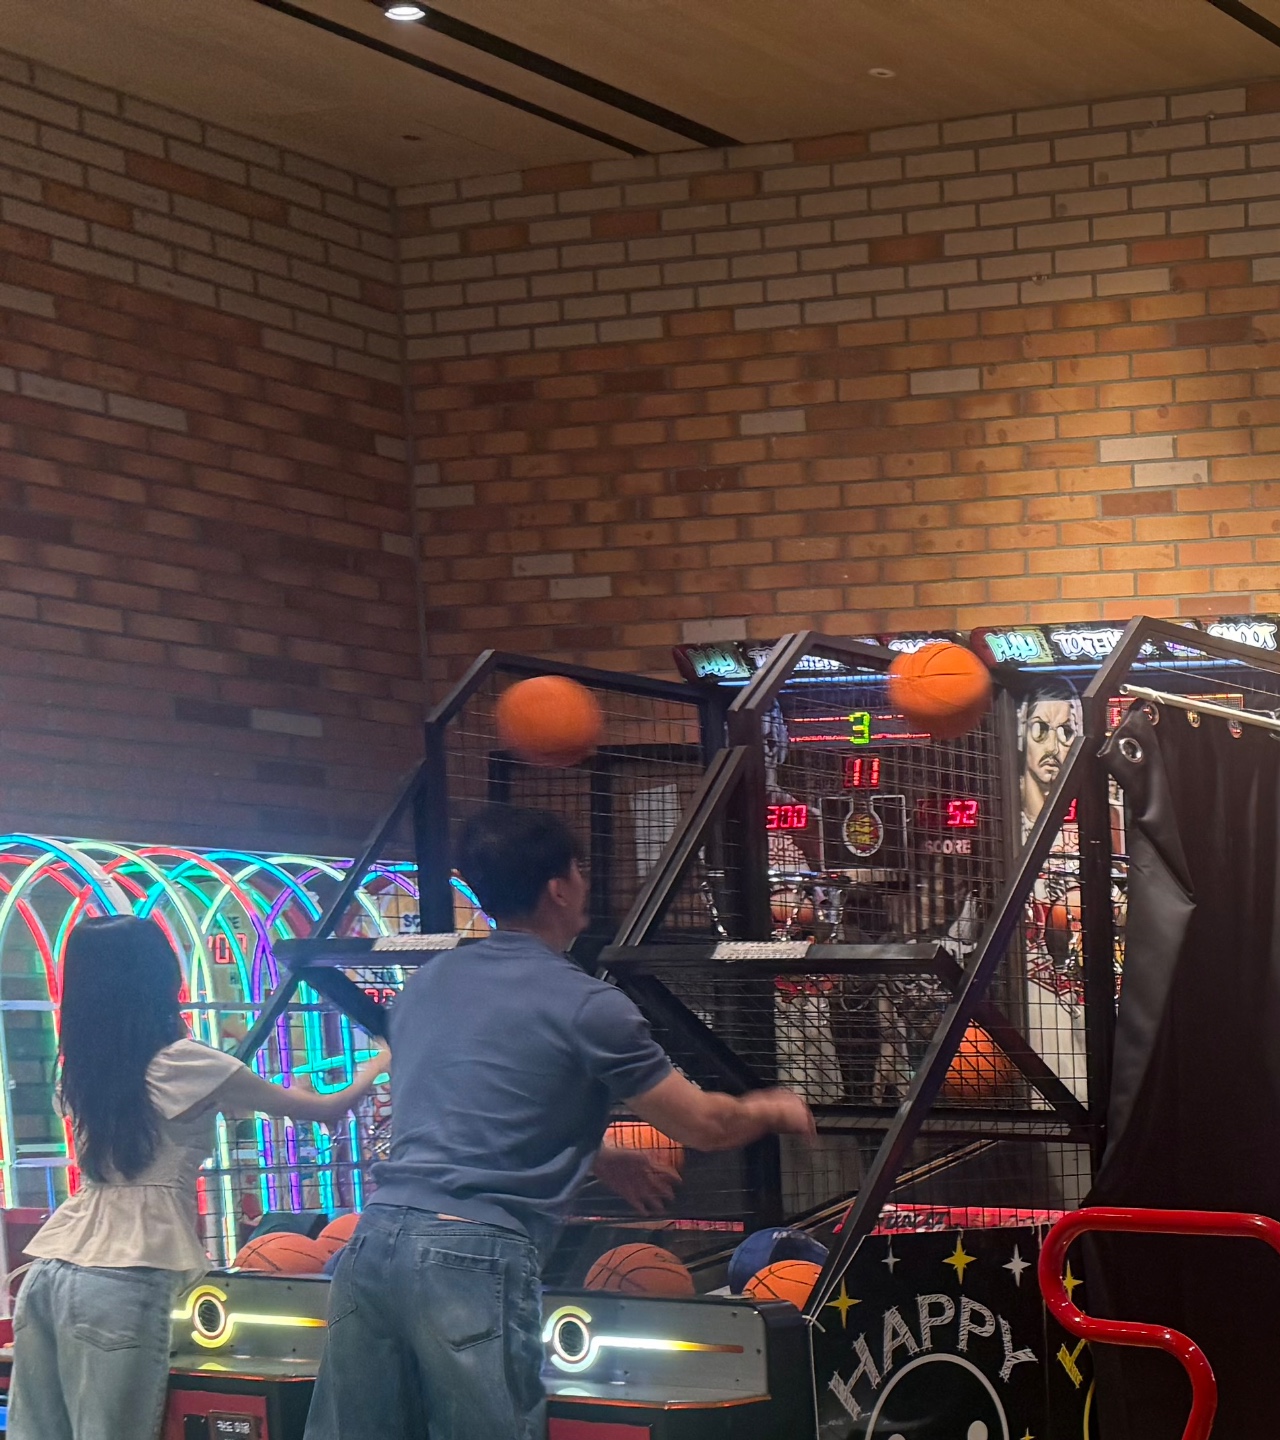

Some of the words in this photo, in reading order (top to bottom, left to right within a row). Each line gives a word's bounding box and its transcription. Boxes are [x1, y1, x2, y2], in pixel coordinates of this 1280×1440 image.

[849, 711, 871, 744] 3
[947, 800, 978, 825] 52
[925, 840, 971, 854] SCORE
[828, 1293, 1038, 1421] HAPPY
